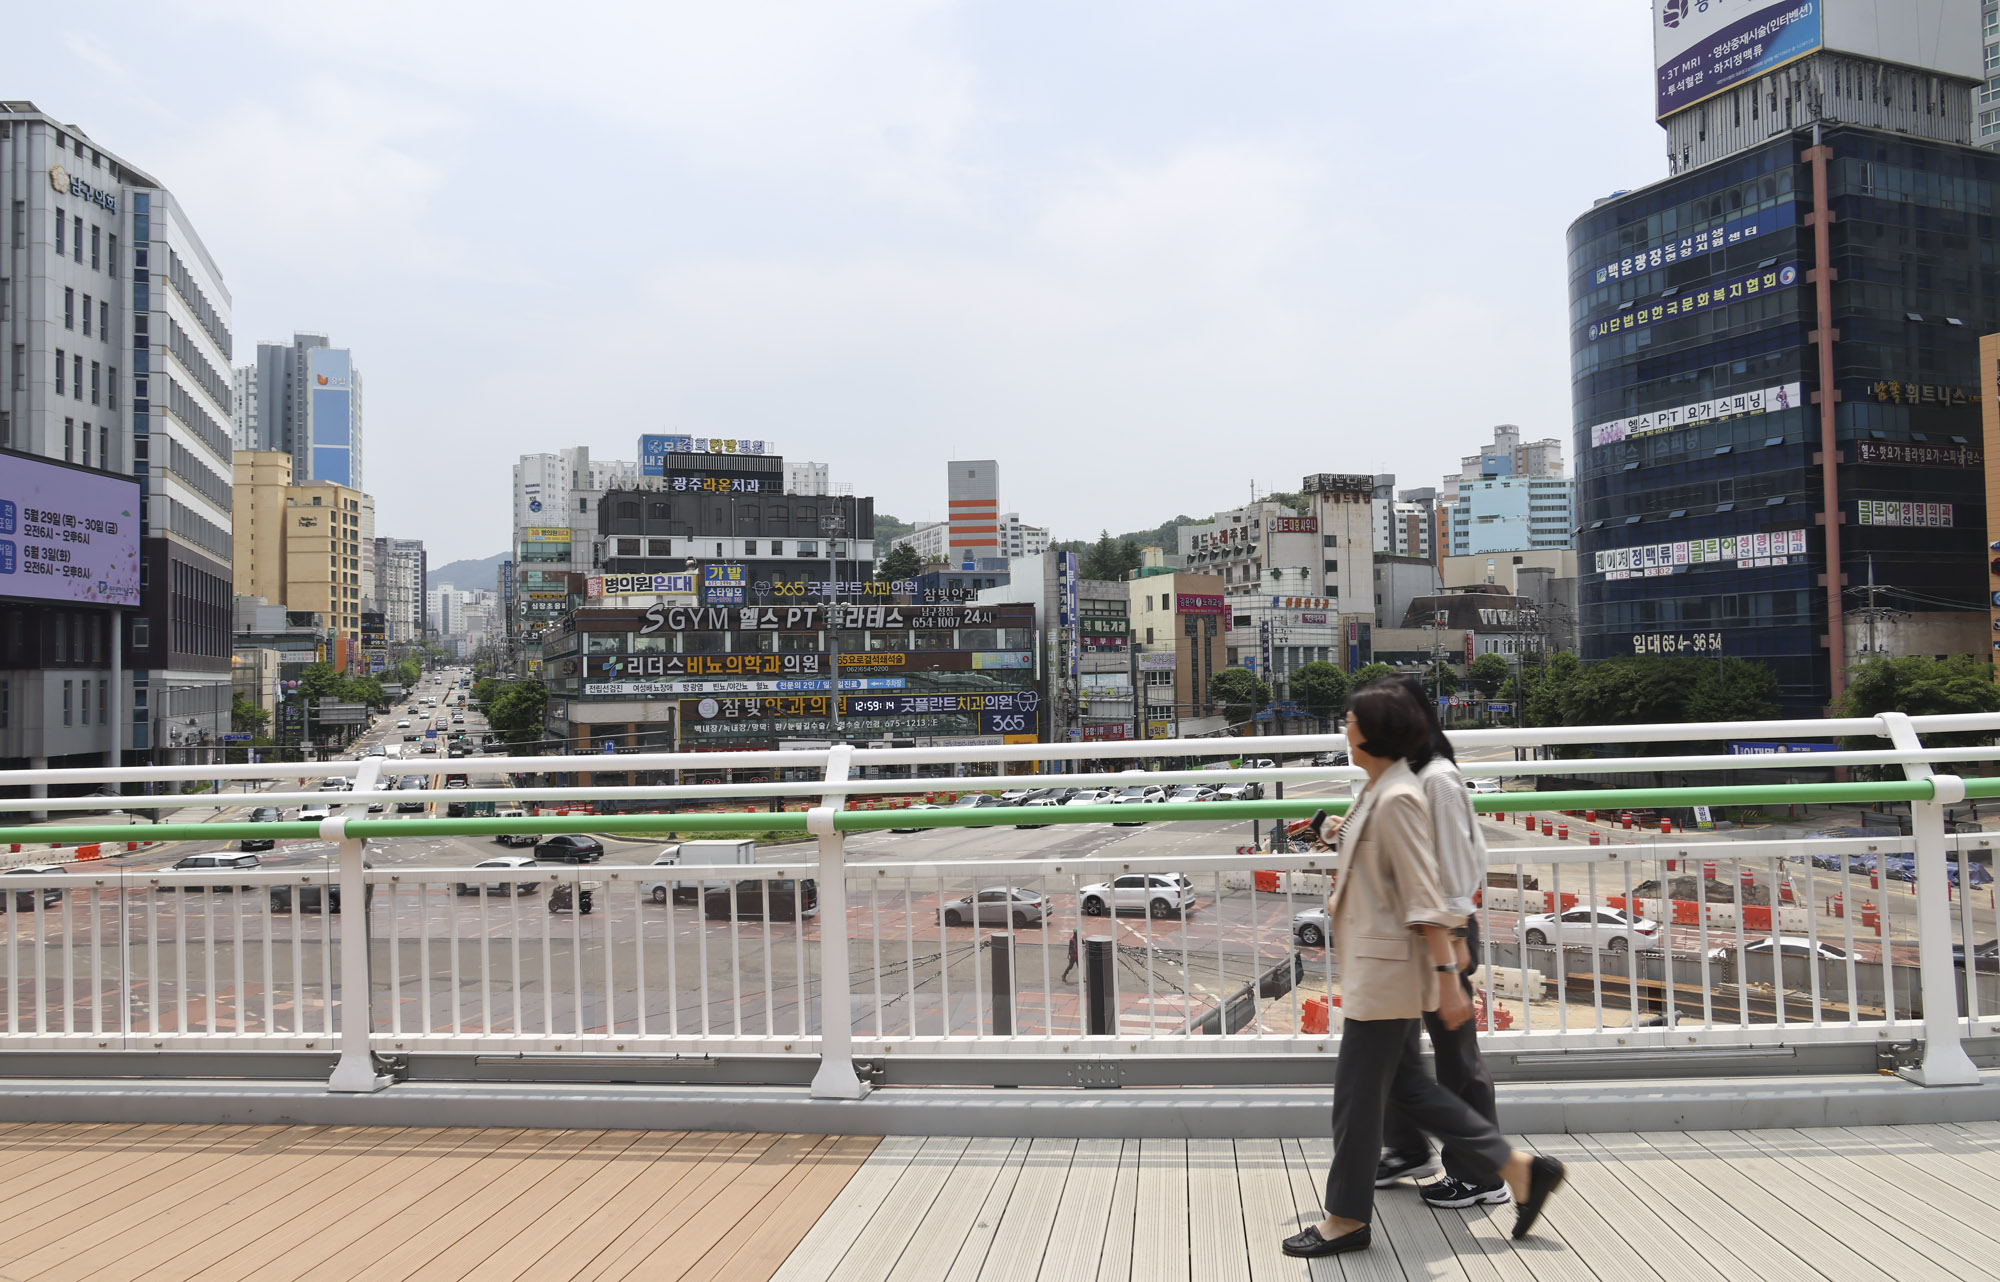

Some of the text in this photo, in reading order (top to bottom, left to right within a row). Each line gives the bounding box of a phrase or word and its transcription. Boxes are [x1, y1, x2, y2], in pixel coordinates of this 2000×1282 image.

[1713, 2, 1813, 59] 영상중재시술(인터벤션)
[1667, 56, 1701, 80] 3T MRI
[1713, 44, 1764, 75] 하지정맥류
[1667, 71, 1704, 97] 투석혈관
[69, 174, 117, 215] 남구의회
[1608, 228, 1724, 280] 백운광장 도시재생
[1905, 383, 1967, 406] 휘트니스
[1628, 414, 1650, 433] 헬스
[1688, 404, 1711, 419] 요가
[1718, 393, 1761, 414] 스피닝
[681, 438, 765, 454] 경희한방병원
[672, 477, 760, 493] 광주라온치과
[24, 508, 39, 523] 5월
[41, 511, 61, 526] 29일
[62, 514, 76, 529] (목)
[85, 519, 104, 533] 30일
[105, 521, 118, 535] (금)
[1859, 502, 1951, 524] 클로아 성형외과
[1902, 515, 1951, 526] 산부인과
[24, 524, 54, 540] 오전6시
[63, 530, 90, 545] 오후6시
[24, 545, 39, 560] 6월
[1690, 538, 1737, 563] 클로아
[1740, 530, 1804, 549] 성형외과
[1740, 543, 1804, 558] 산부인과
[24, 561, 54, 576] 오전6시
[63, 565, 90, 579] 오후8시
[709, 566, 742, 580] 가발
[604, 575, 692, 594] 병의원임대
[708, 588, 742, 597] 스타일모
[774, 581, 918, 596] 365 굿플란트치과의원
[924, 588, 979, 602] 참빛안과
[740, 607, 779, 629] 헬스
[786, 607, 817, 629] PT
[825, 607, 904, 629] 필라테스
[912, 610, 992, 628] 654-1007 24시
[1633, 633, 1722, 654] 임대 654-3654
[627, 655, 819, 676] 리더스비뇨의학과의원
[834, 654, 903, 666] 65요로결석쇄석술
[589, 685, 623, 693] 전립선검진
[633, 683, 673, 692] 여성배뇨장애
[683, 683, 704, 692] 방광염
[713, 682, 748, 691] 빈뇨/야간뇨
[756, 681, 769, 690] 혈뇨
[780, 681, 802, 690] 전문의
[803, 681, 816, 689] 2인
[823, 679, 858, 689] 일일진료
[855, 701, 895, 711] 12:59:14
[901, 695, 1013, 713] 굿플란트치과의원
[885, 719, 925, 727] 675-1213
[992, 715, 1025, 731] 365
